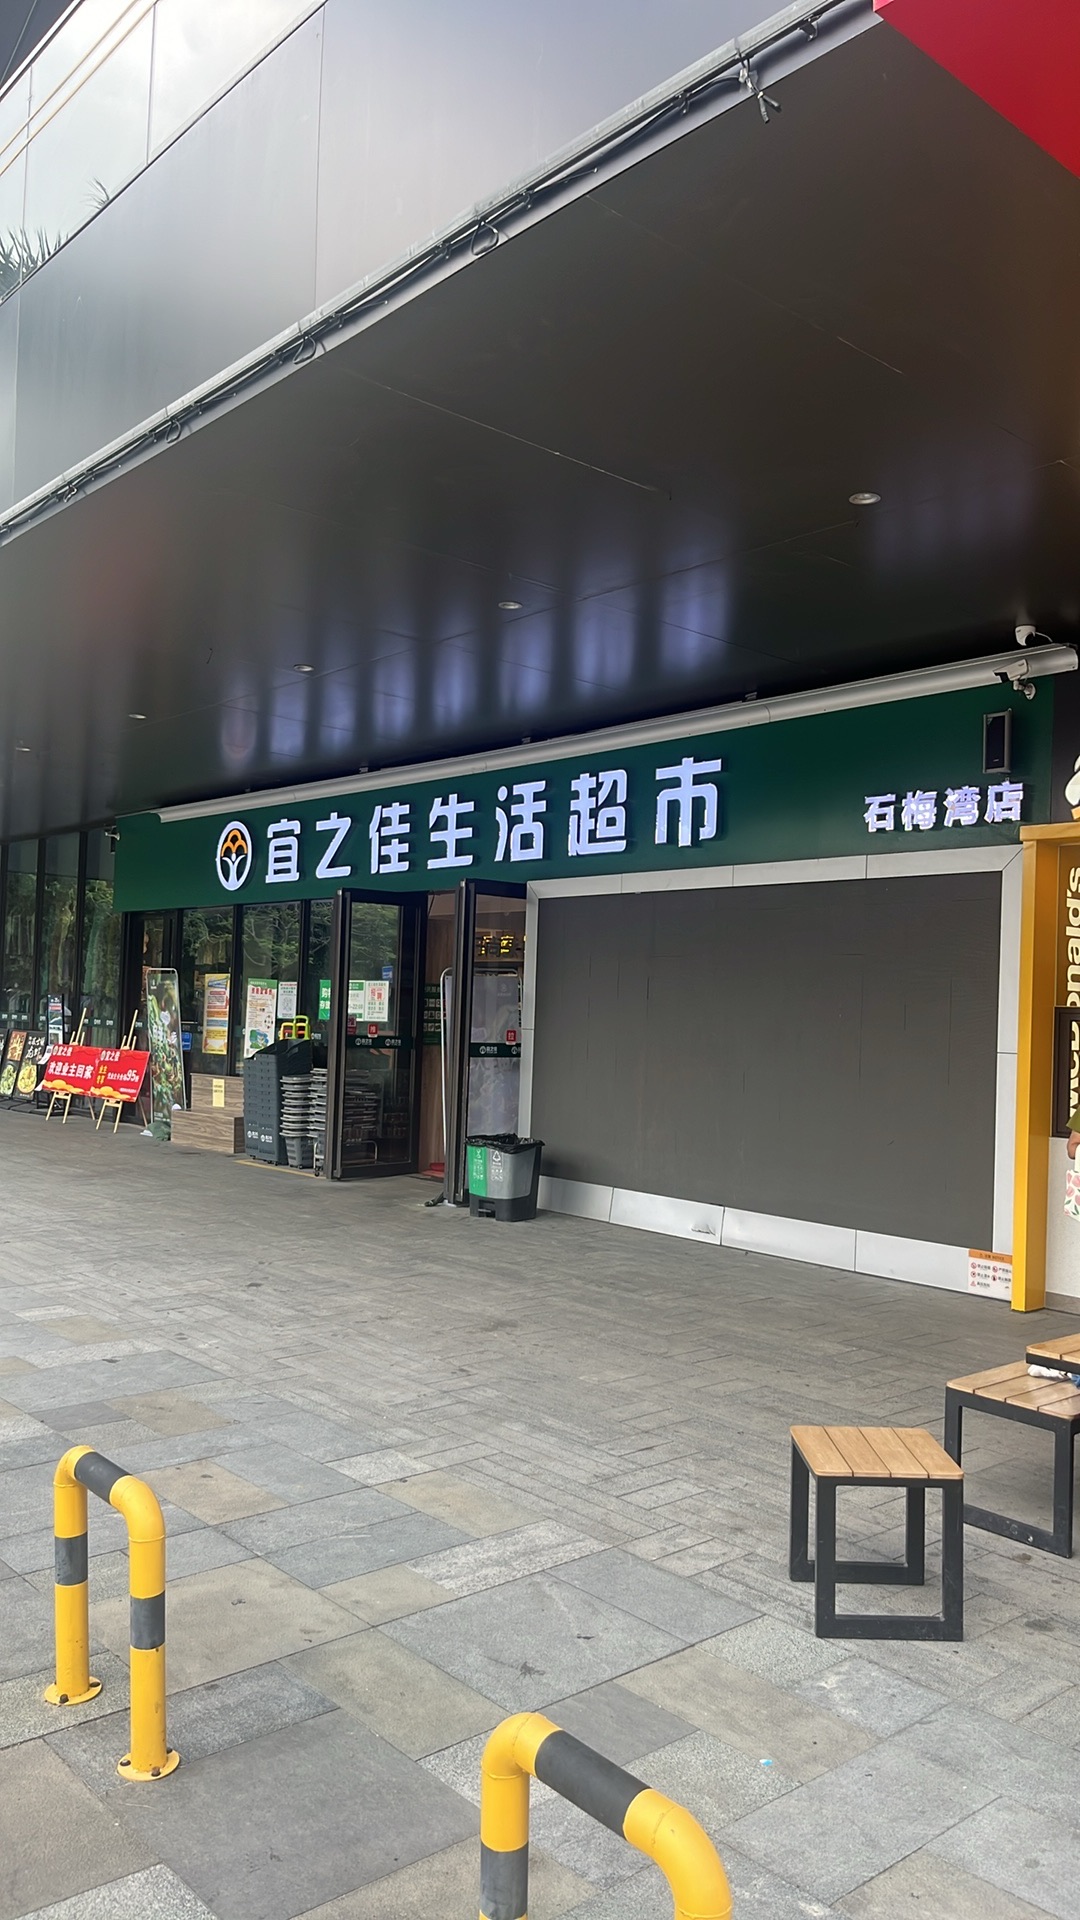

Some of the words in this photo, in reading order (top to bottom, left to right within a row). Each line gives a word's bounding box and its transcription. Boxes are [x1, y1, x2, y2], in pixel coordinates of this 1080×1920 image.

[265, 757, 722, 884] 宜之佳生活超市
[863, 781, 1024, 832] 石梅湾店
[48, 1061, 93, 1079] 欢迎业主回家
